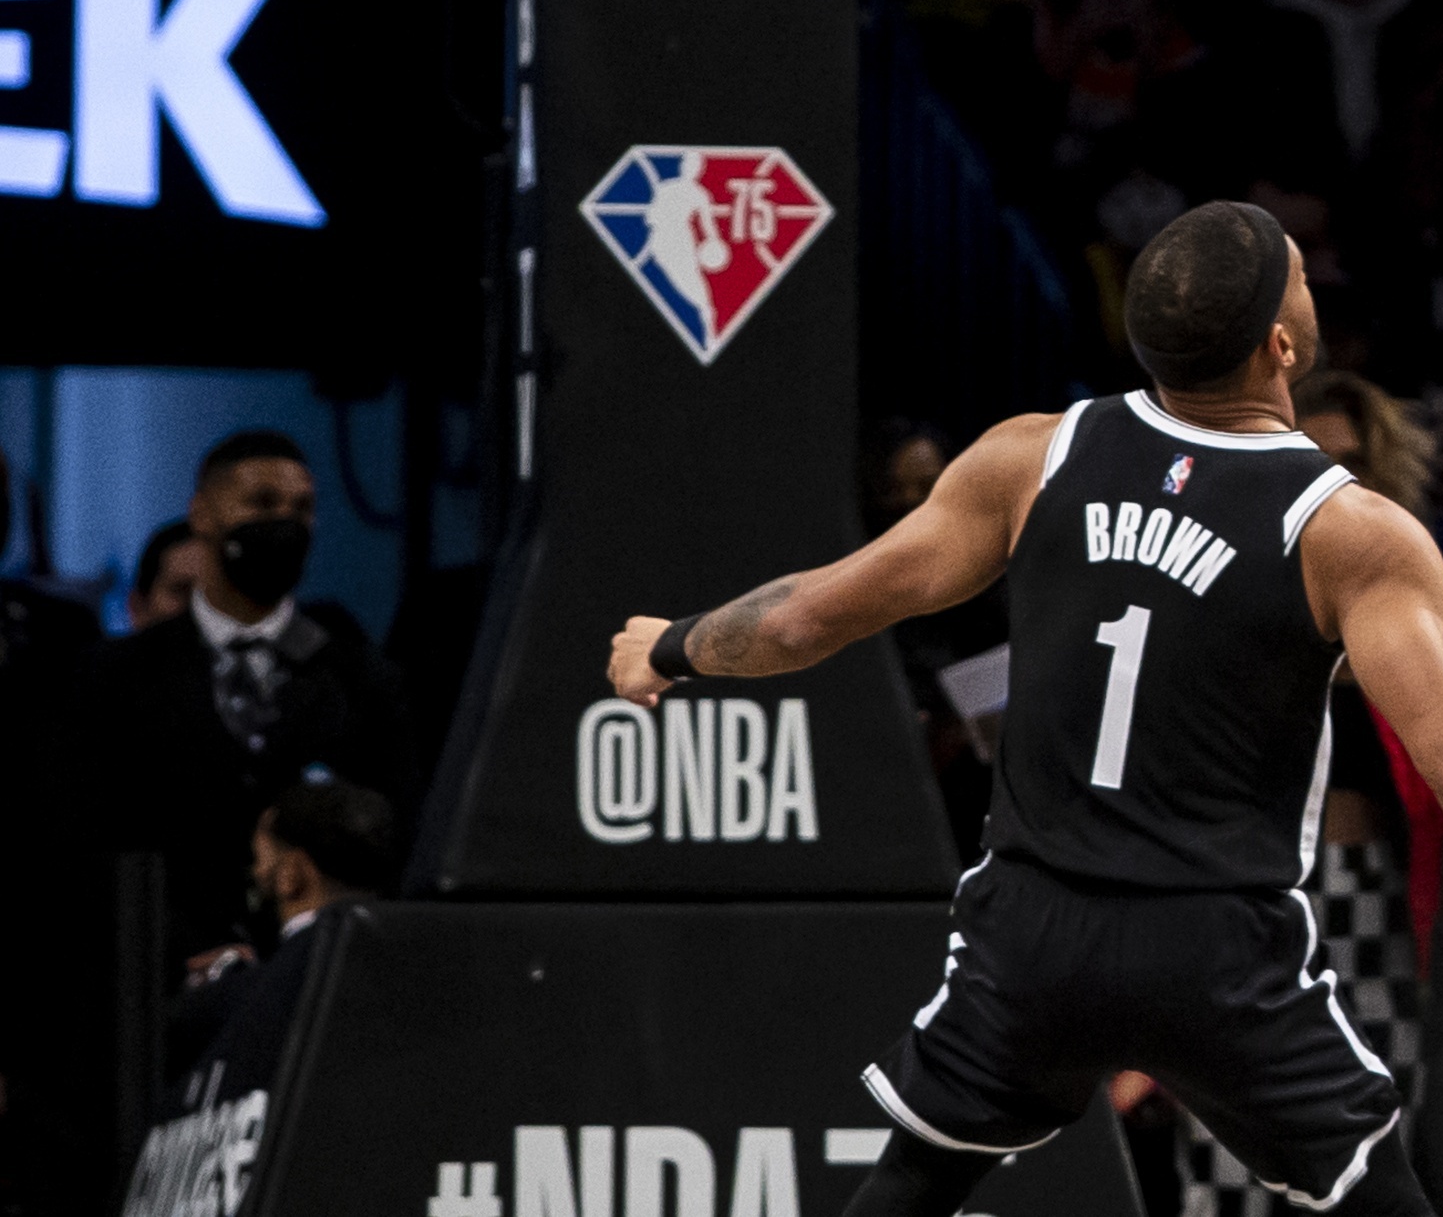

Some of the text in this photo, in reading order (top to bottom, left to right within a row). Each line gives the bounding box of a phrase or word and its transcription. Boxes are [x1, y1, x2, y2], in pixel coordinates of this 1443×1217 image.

[726, 178, 776, 243] 75
[1085, 501, 1238, 598] BROWN
[1090, 603, 1152, 790] 1
[577, 697, 820, 844] @NBA
